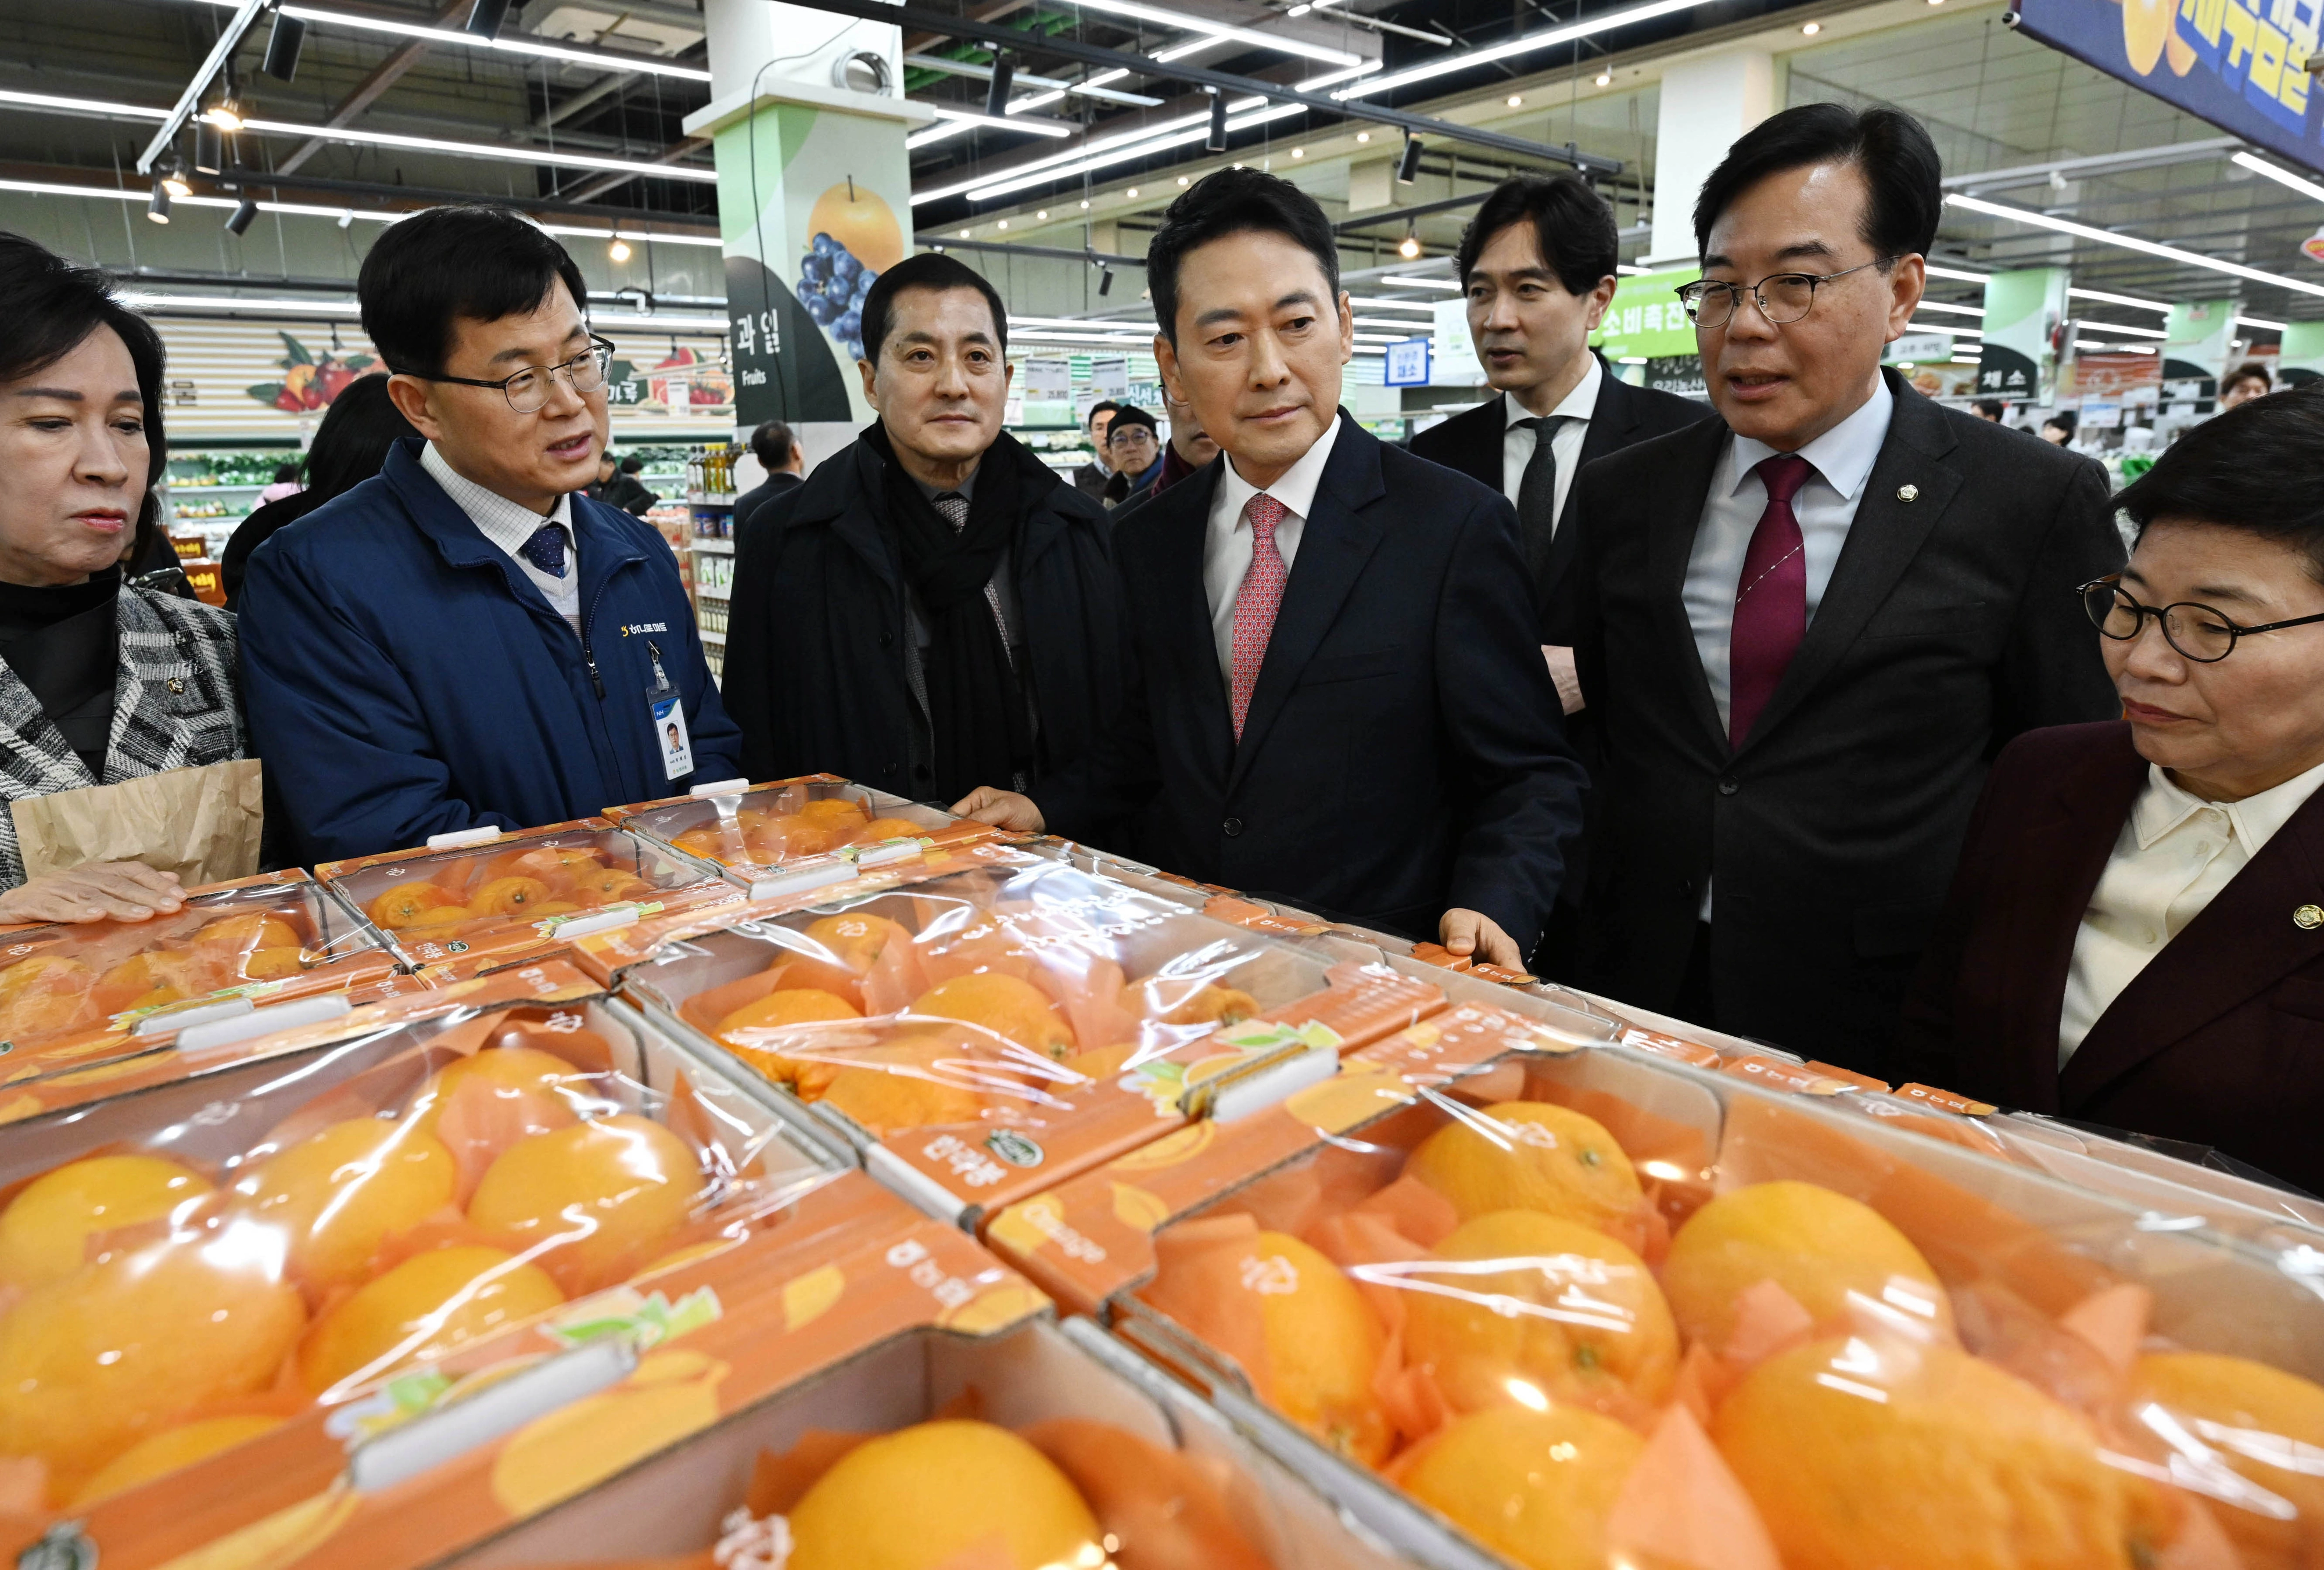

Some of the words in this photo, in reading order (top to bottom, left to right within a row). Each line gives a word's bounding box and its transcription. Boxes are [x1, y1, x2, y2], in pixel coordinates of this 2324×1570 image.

[2180, 0, 2323, 117] 감귤
[1602, 302, 1685, 337] 소비촉진
[737, 308, 780, 355] 과일
[741, 368, 766, 386] Fruits
[1982, 369, 2027, 389] 채소
[629, 623, 668, 634] 하나로마트
[415, 942, 446, 958] 한라봉
[435, 966, 457, 982] Orange
[1023, 1203, 1107, 1264] Orange
